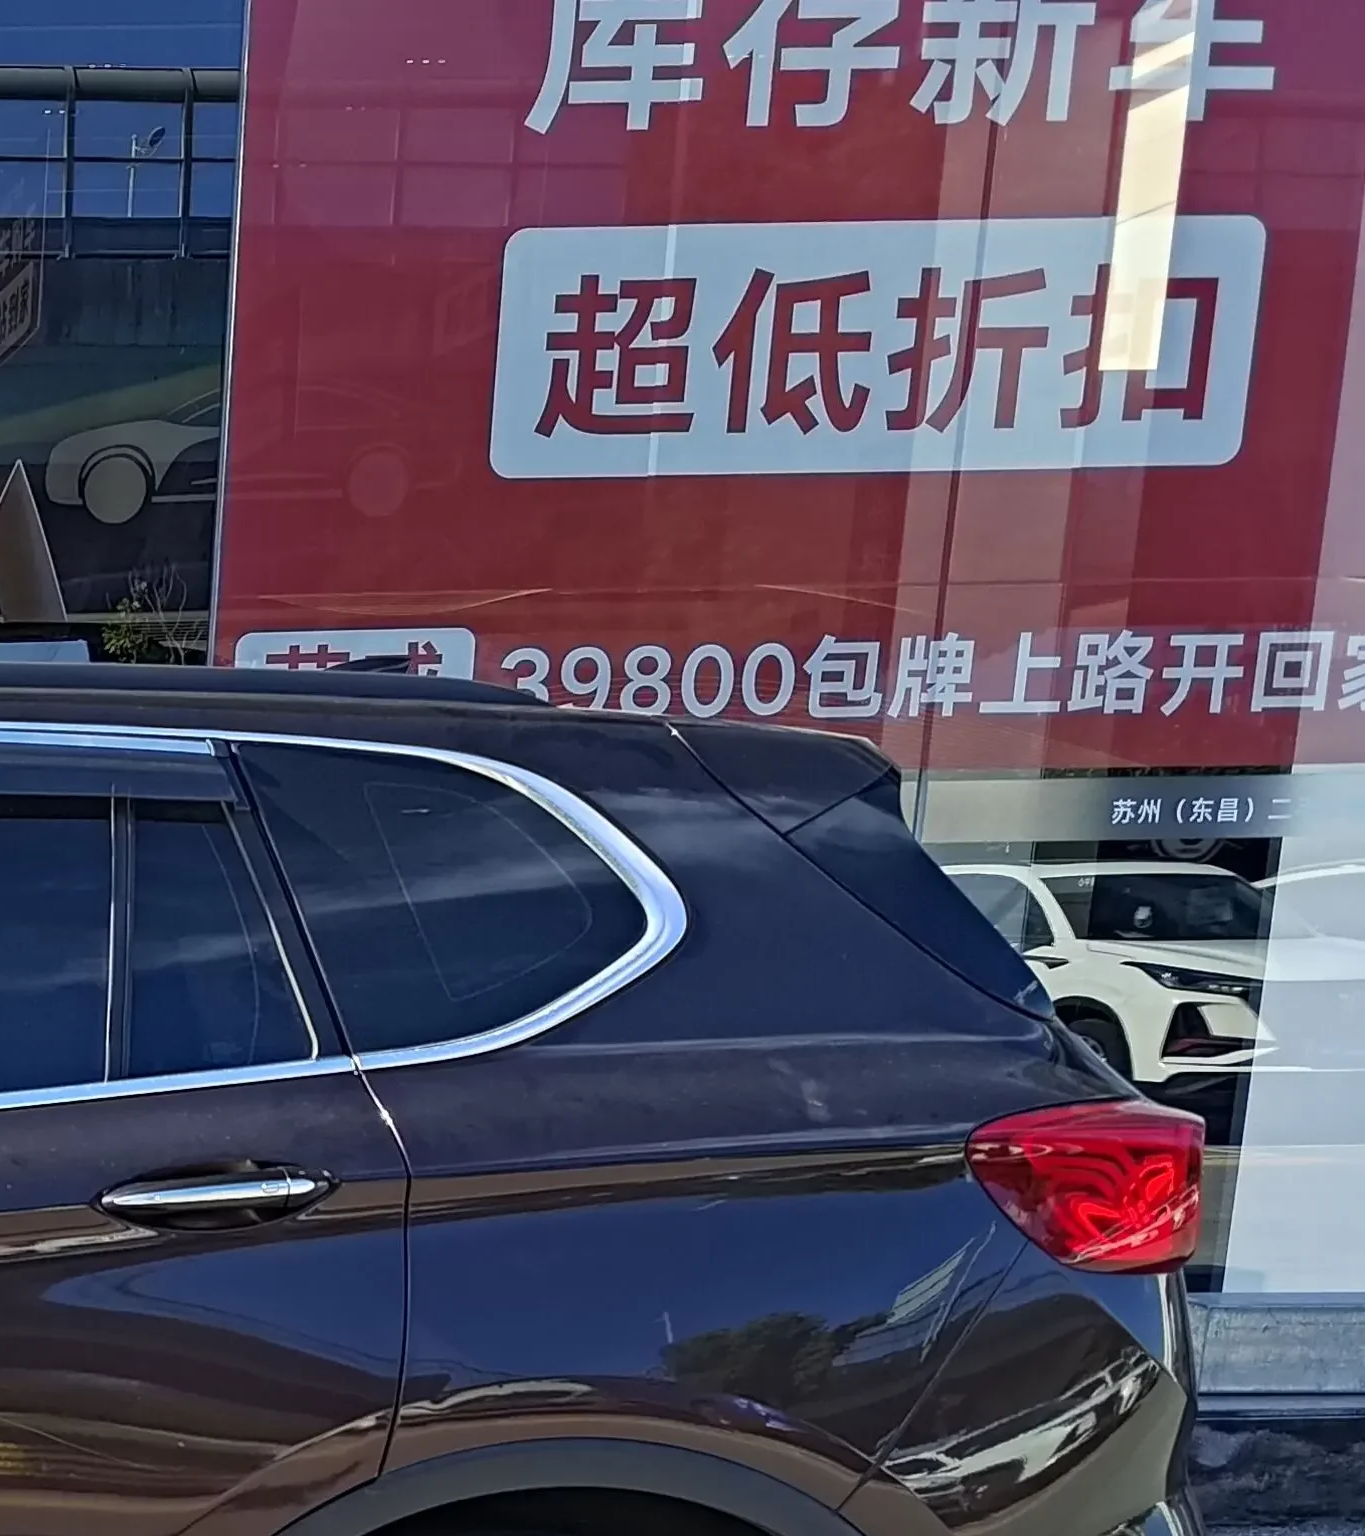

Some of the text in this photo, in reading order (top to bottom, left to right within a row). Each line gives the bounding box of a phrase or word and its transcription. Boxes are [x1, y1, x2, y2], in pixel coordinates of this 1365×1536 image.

[524, 0, 1275, 134] 库存新车
[533, 266, 1225, 441] 超低折扣
